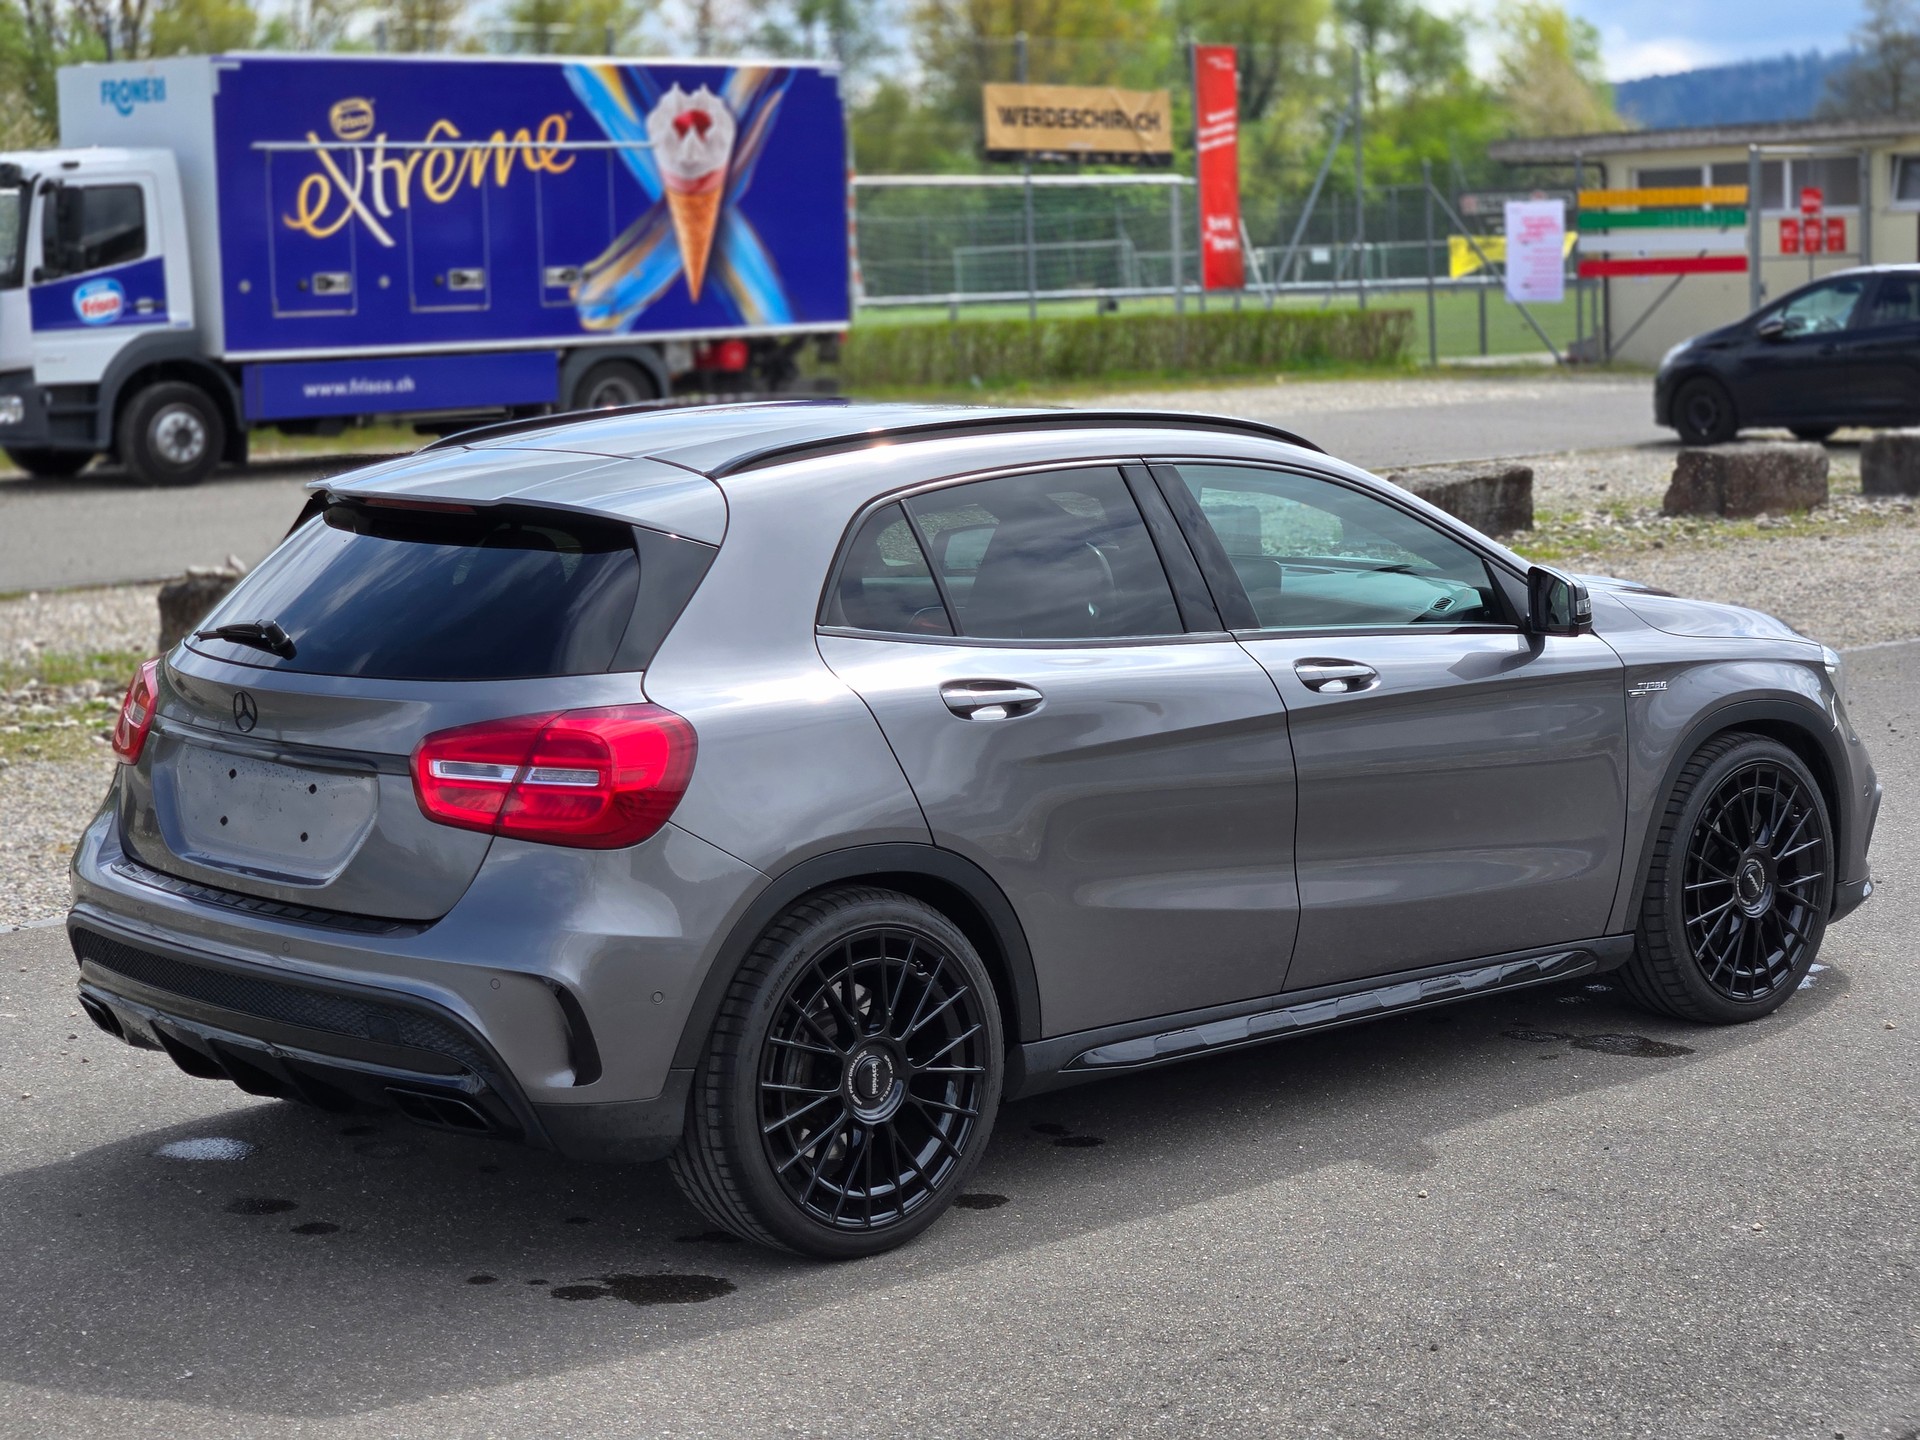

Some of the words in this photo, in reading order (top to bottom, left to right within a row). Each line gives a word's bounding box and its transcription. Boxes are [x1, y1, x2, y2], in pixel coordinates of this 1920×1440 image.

[100, 77, 166, 106] FRONERI
[1637, 681, 1667, 690] TURBO
[847, 1050, 868, 1094] PERFORMANCE
